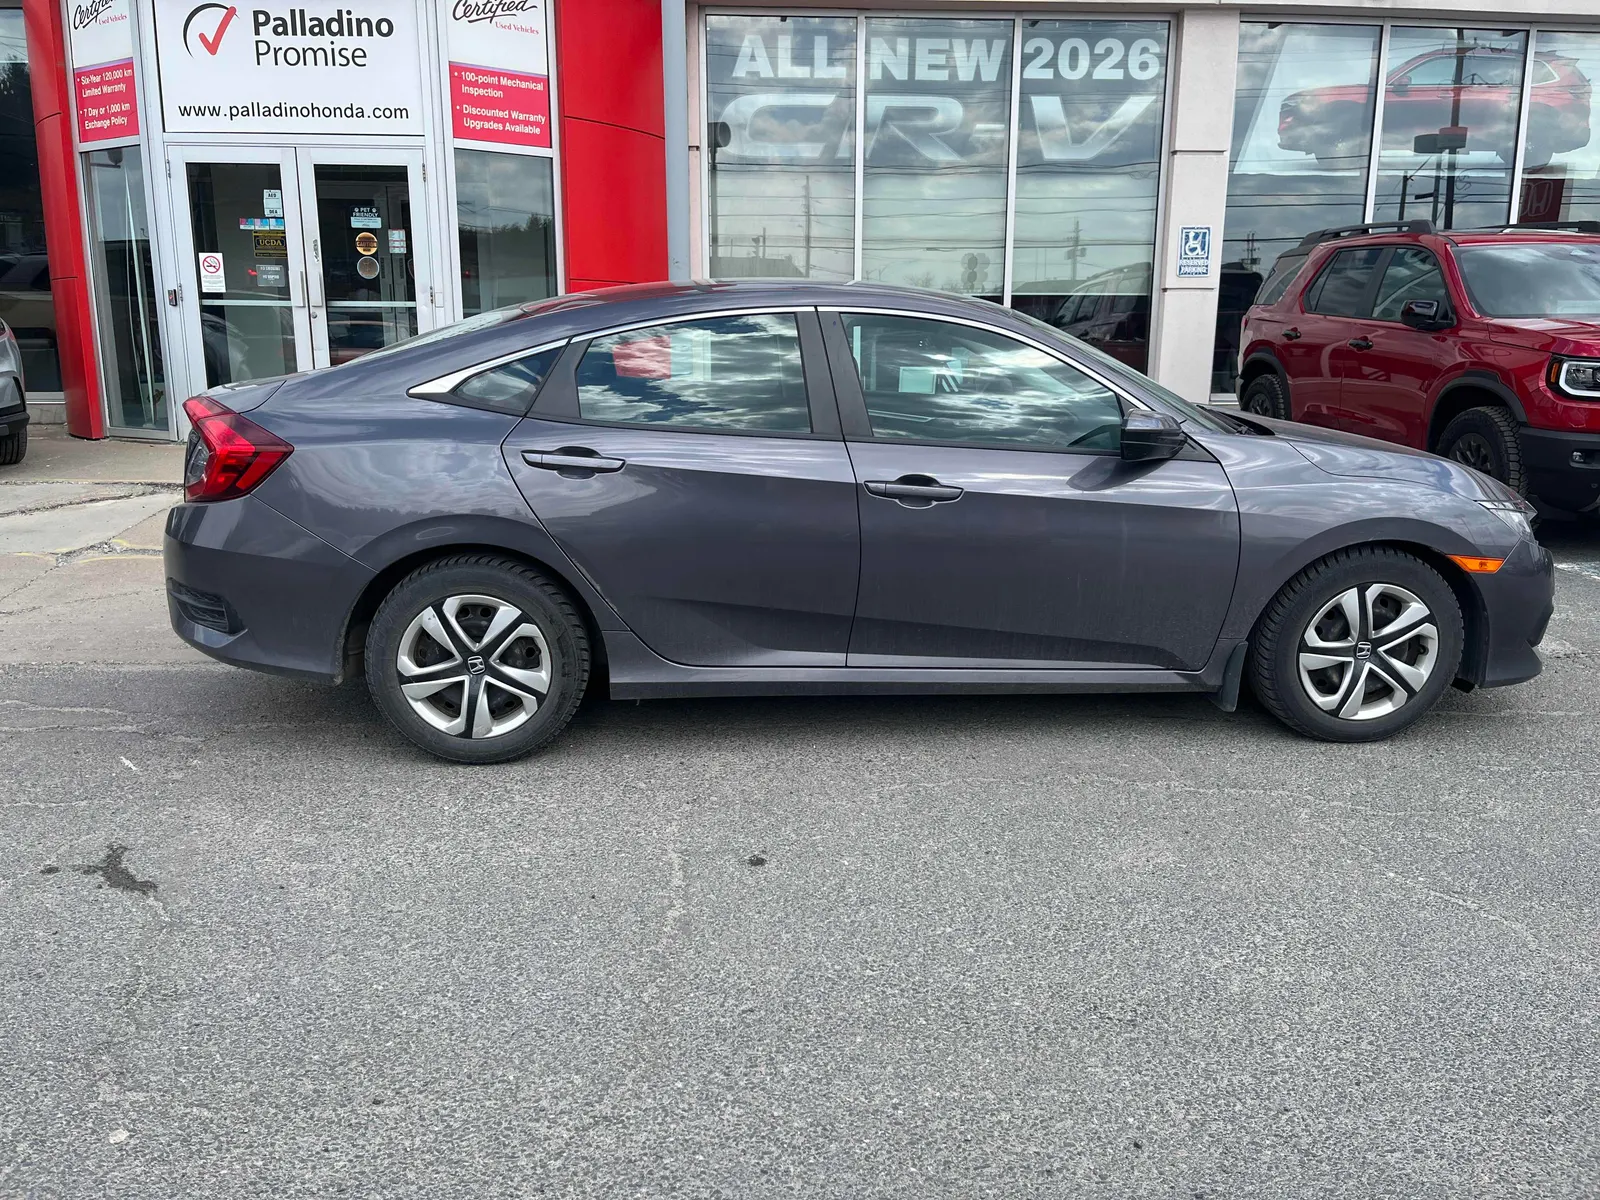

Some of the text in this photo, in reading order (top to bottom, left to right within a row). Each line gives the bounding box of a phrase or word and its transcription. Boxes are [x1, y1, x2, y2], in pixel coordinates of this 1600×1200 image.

[452, 0, 538, 24] Certified
[252, 8, 394, 38] Palladino
[495, 22, 539, 35] Used Vehicles
[254, 40, 367, 67] Promise
[731, 34, 1160, 82] ALL NEW 2026
[81, 68, 132, 85] Six-Year 120,000 km
[461, 71, 543, 91] 100-point Mechanical
[82, 82, 126, 97] Limited Warranty
[461, 84, 503, 98] Inspection
[88, 107, 98, 117] Day
[107, 103, 120, 114] 1,000
[121, 102, 130, 111] km
[178, 101, 409, 121] www.palladinohonda.com
[463, 104, 546, 125] Discounted Warranty
[85, 115, 127, 130] Exchange Policy
[463, 117, 541, 135] Upgrades Available
